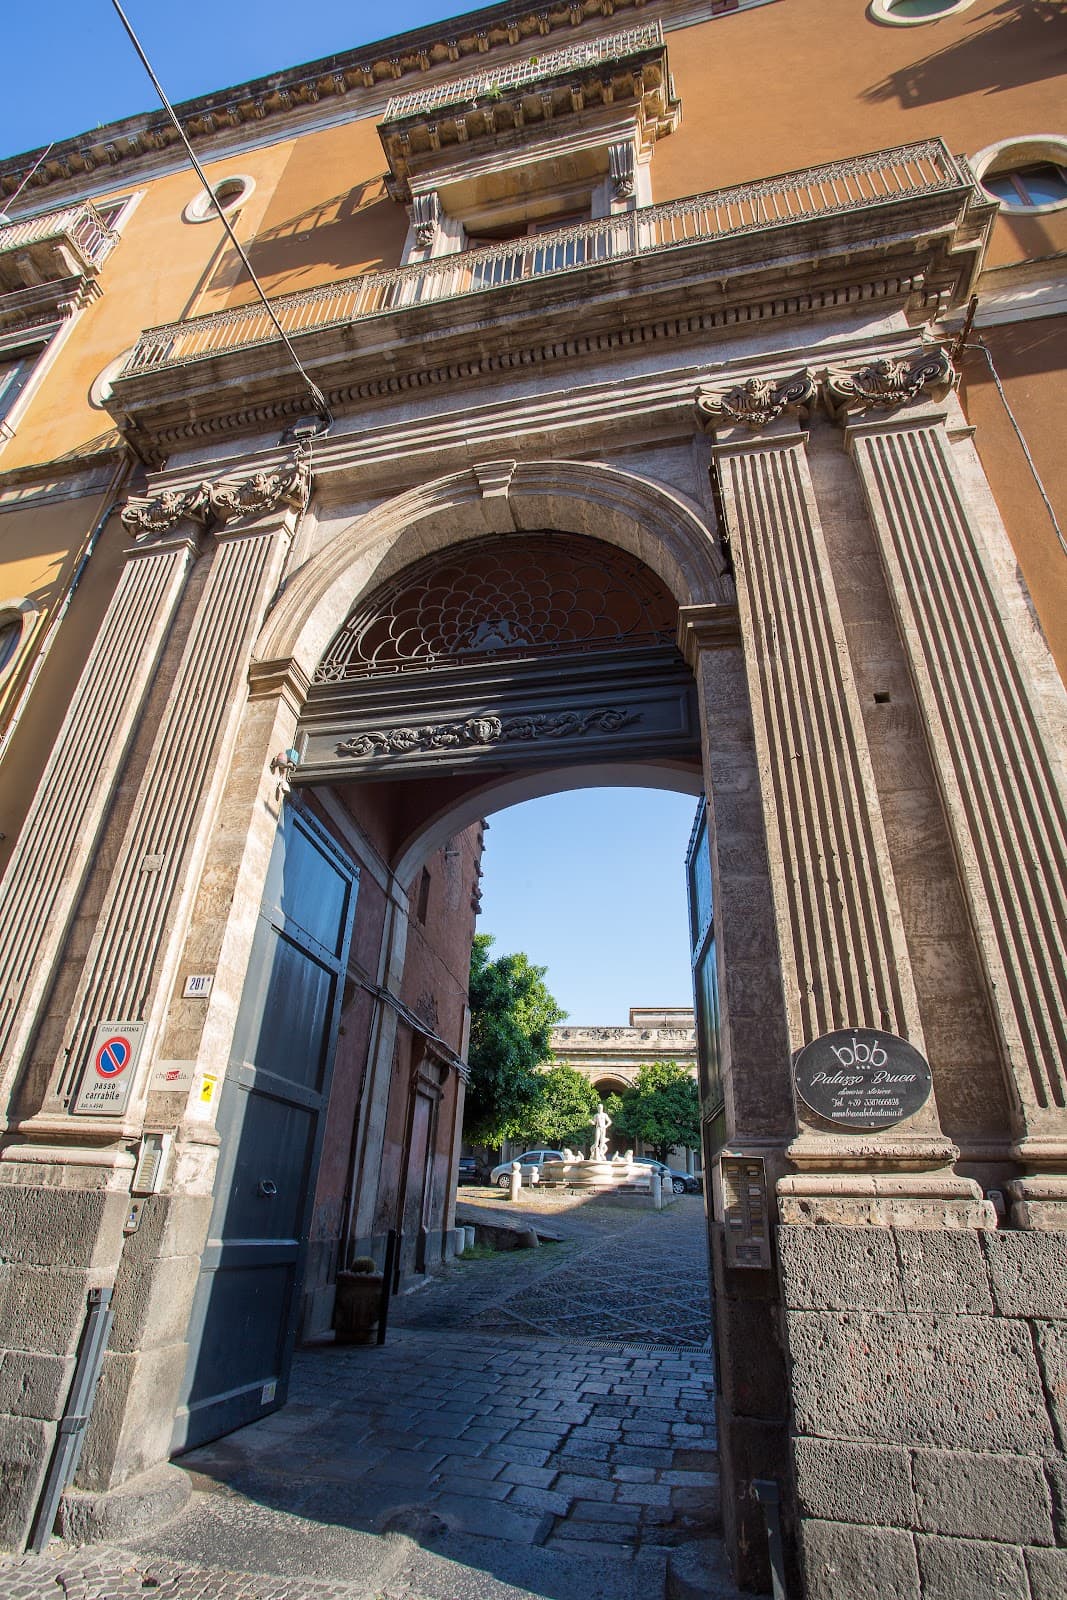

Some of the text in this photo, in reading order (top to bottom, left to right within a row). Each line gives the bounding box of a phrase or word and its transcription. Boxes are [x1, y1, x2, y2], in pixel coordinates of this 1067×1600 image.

[829, 1037, 888, 1067] bbb
[810, 1070, 917, 1086] Palazzo Bruca
[94, 1082, 116, 1091] passo
[85, 1091, 120, 1100] carrabile
[847, 1098, 862, 1107] +39
